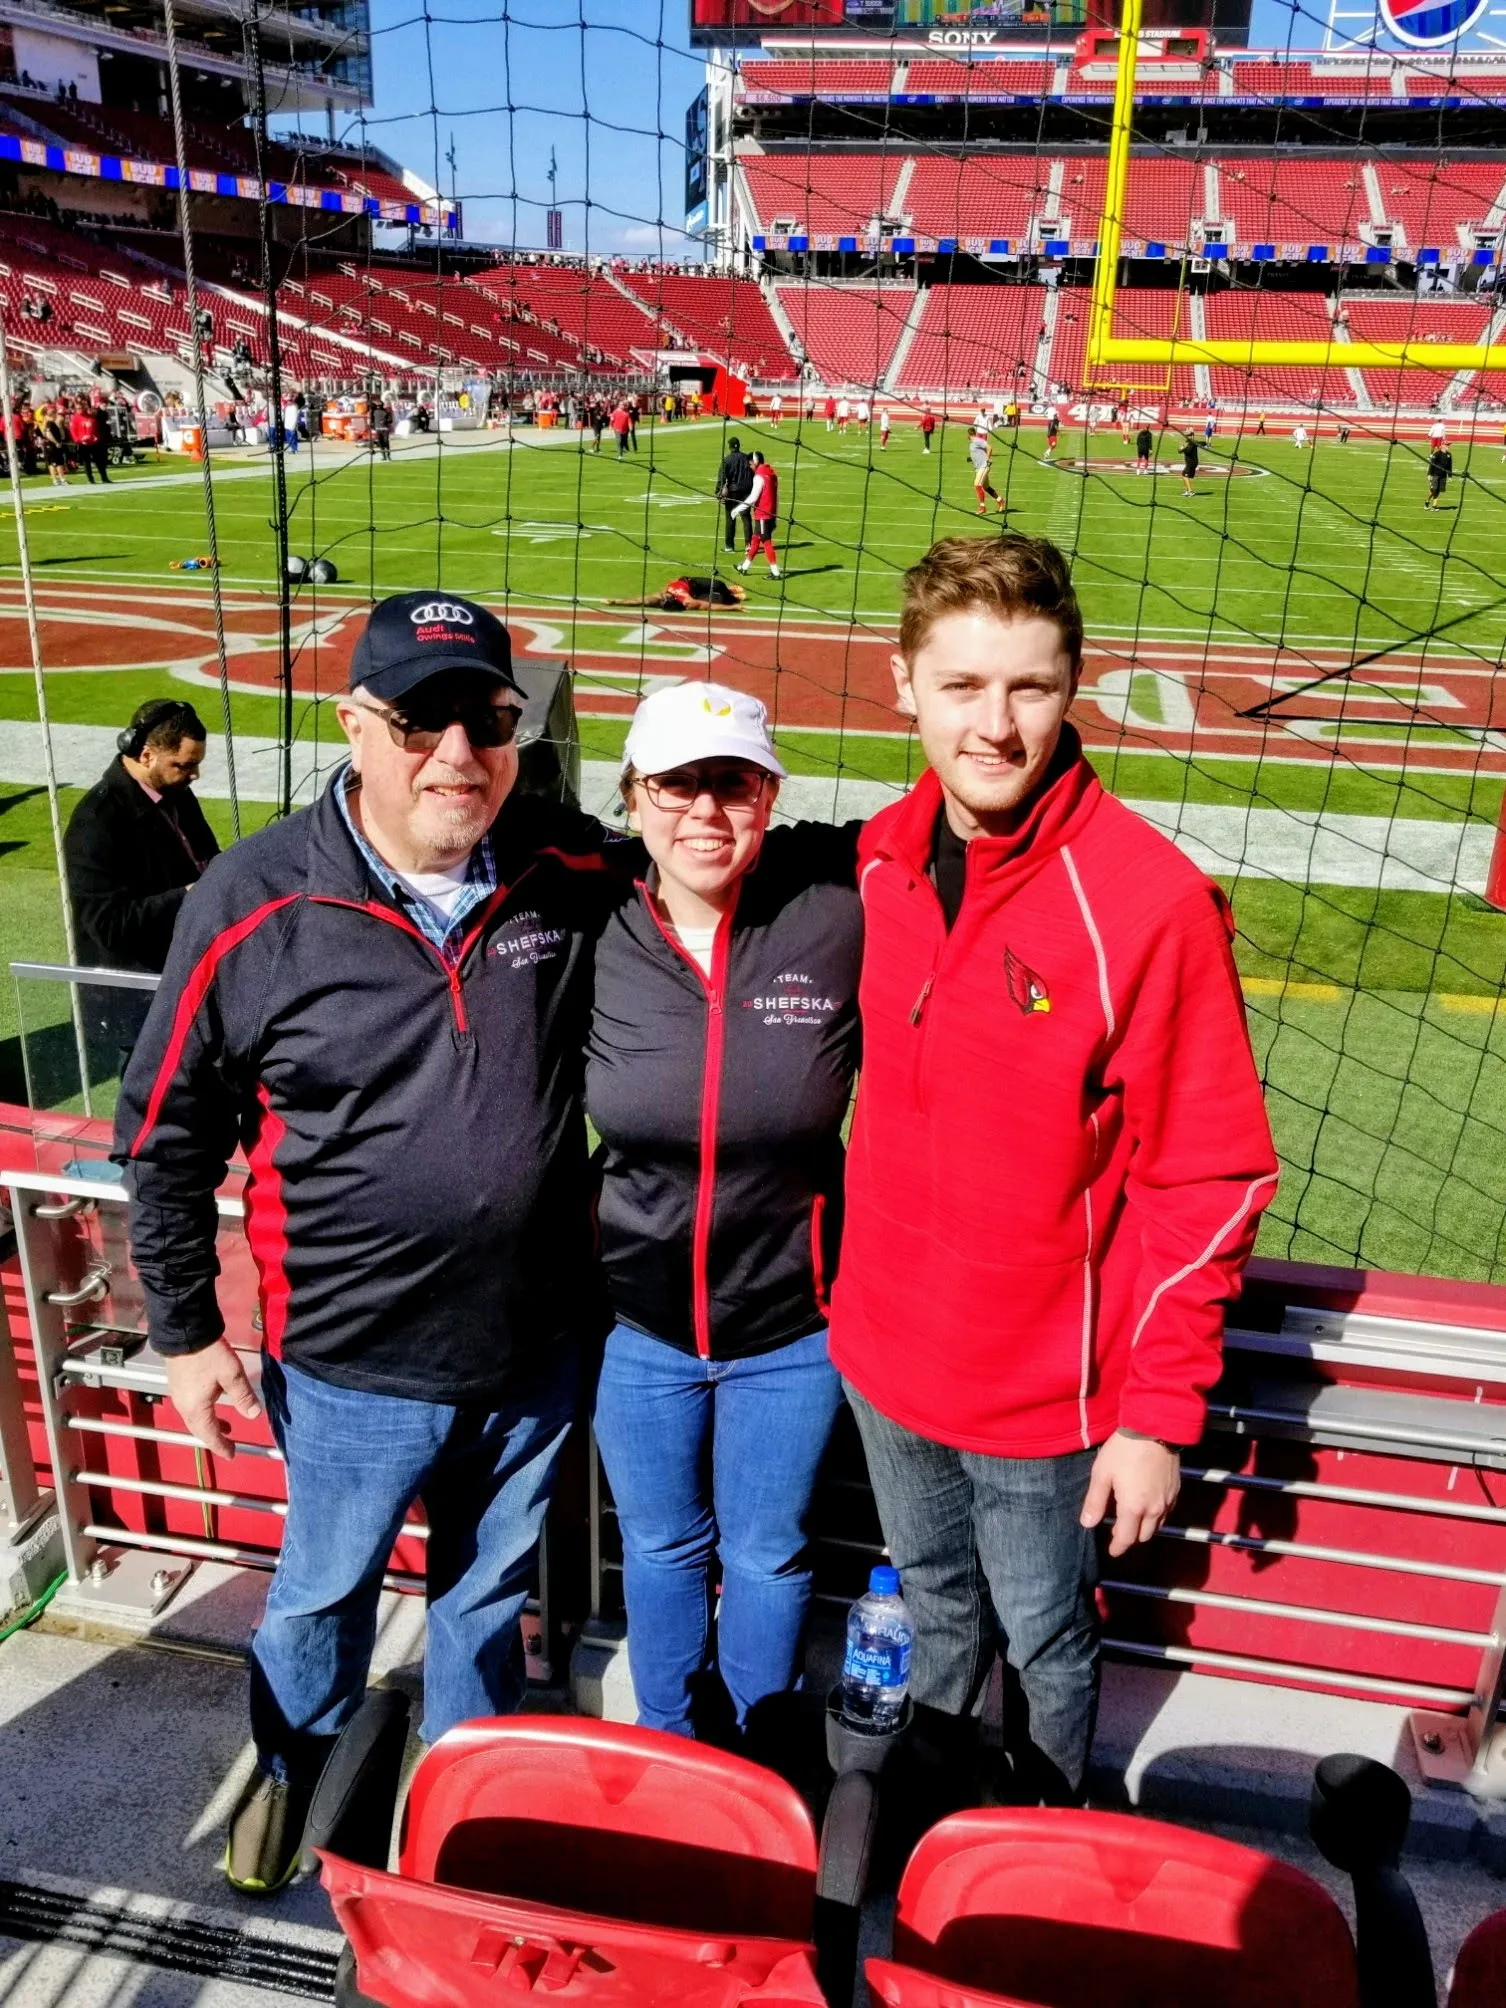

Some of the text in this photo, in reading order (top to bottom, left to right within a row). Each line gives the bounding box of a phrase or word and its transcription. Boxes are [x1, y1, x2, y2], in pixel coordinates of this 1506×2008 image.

[928, 31, 997, 45] SONY
[1144, 30, 1181, 39] STADIUM
[416, 624, 445, 635] Audi
[513, 910, 538, 923] TEAM
[496, 929, 561, 955] SHEFSKA
[776, 973, 809, 984] TEAM
[753, 997, 834, 1011] SHEFSKA
[763, 1013, 782, 1026] San
[852, 1648, 892, 1667] AQUAFINA
